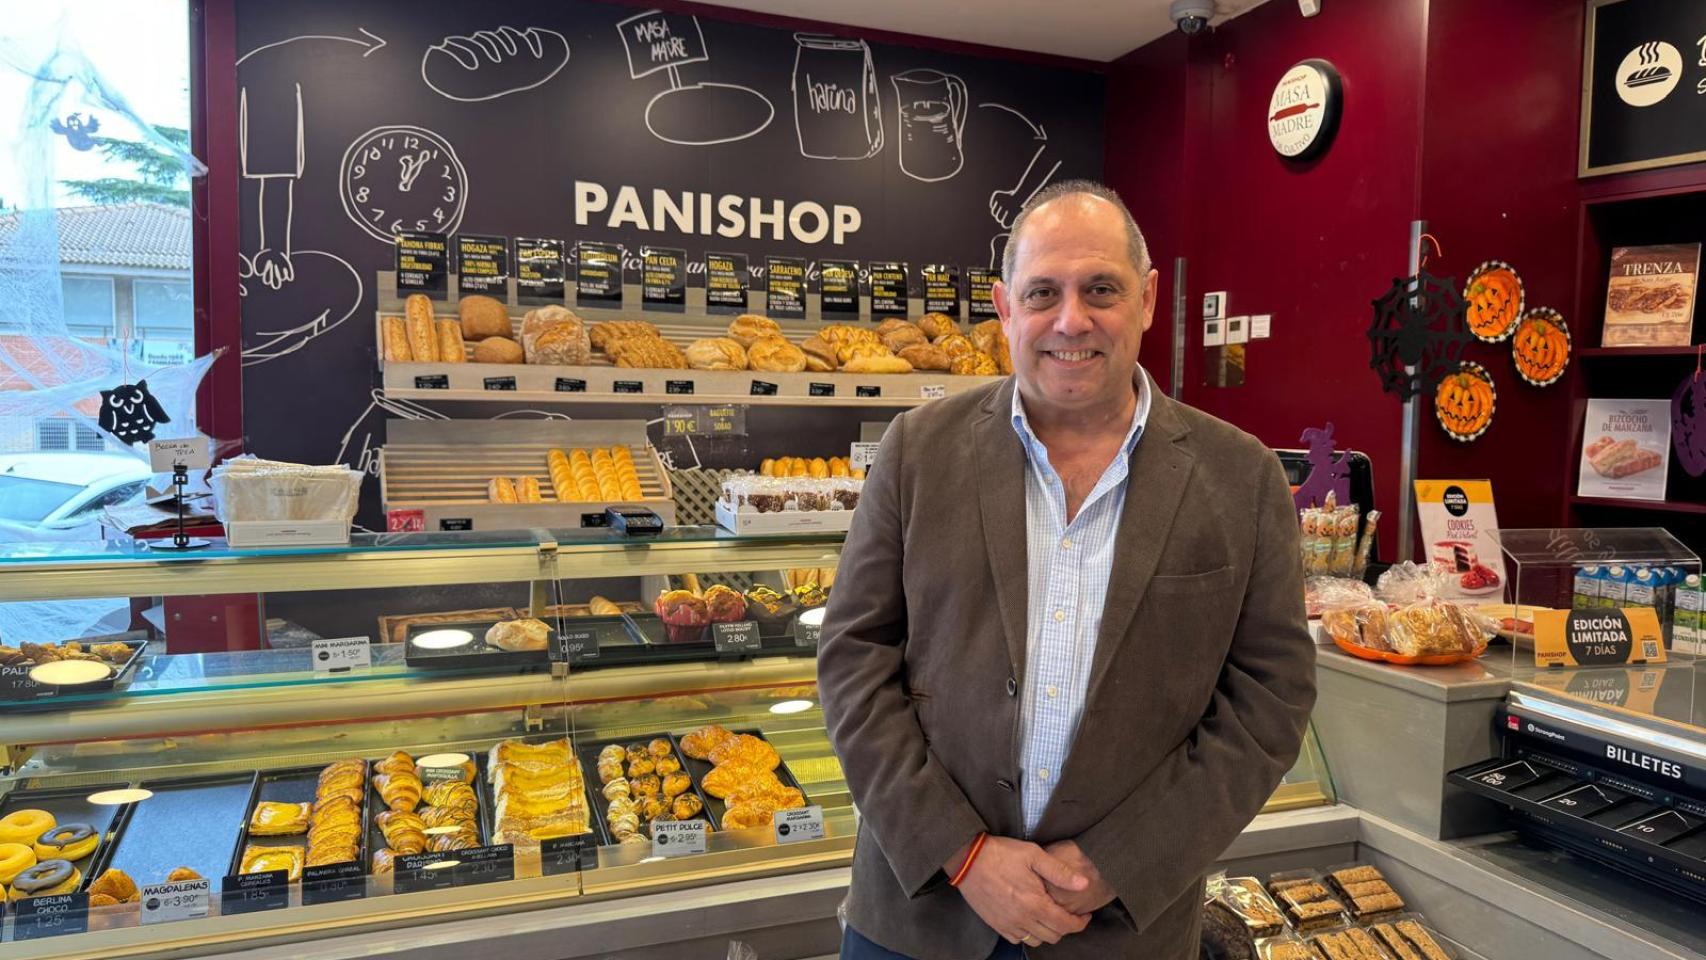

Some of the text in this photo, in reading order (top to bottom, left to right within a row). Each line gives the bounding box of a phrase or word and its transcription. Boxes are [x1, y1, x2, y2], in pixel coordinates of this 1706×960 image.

[634, 18, 671, 43] MASA
[807, 73, 856, 114] harina
[1274, 84, 1311, 109] MASA
[1272, 114, 1313, 138] MADRE
[575, 180, 862, 245] PANISHOP
[708, 260, 734, 271] HOGAZA
[1623, 261, 1683, 276] TRENZA
[1609, 414, 1648, 424] BIZCOCHO
[1602, 423, 1653, 433] DE MANZANA
[1447, 519, 1475, 530] COOKIES
[1573, 615, 1623, 631] EDICIÓN
[1571, 631, 1628, 643] LIMITADA
[1586, 643, 1616, 656] 7 DÍAS
[1607, 744, 1682, 779] BILLETES
[1558, 798, 1577, 806] 20
[655, 823, 703, 832] PETIT DULCE
[1636, 825, 1655, 833] 10
[143, 881, 208, 896] MAGDALENAS
[33, 895, 72, 906] BERLINA
[36, 905, 68, 914] CHOCO
